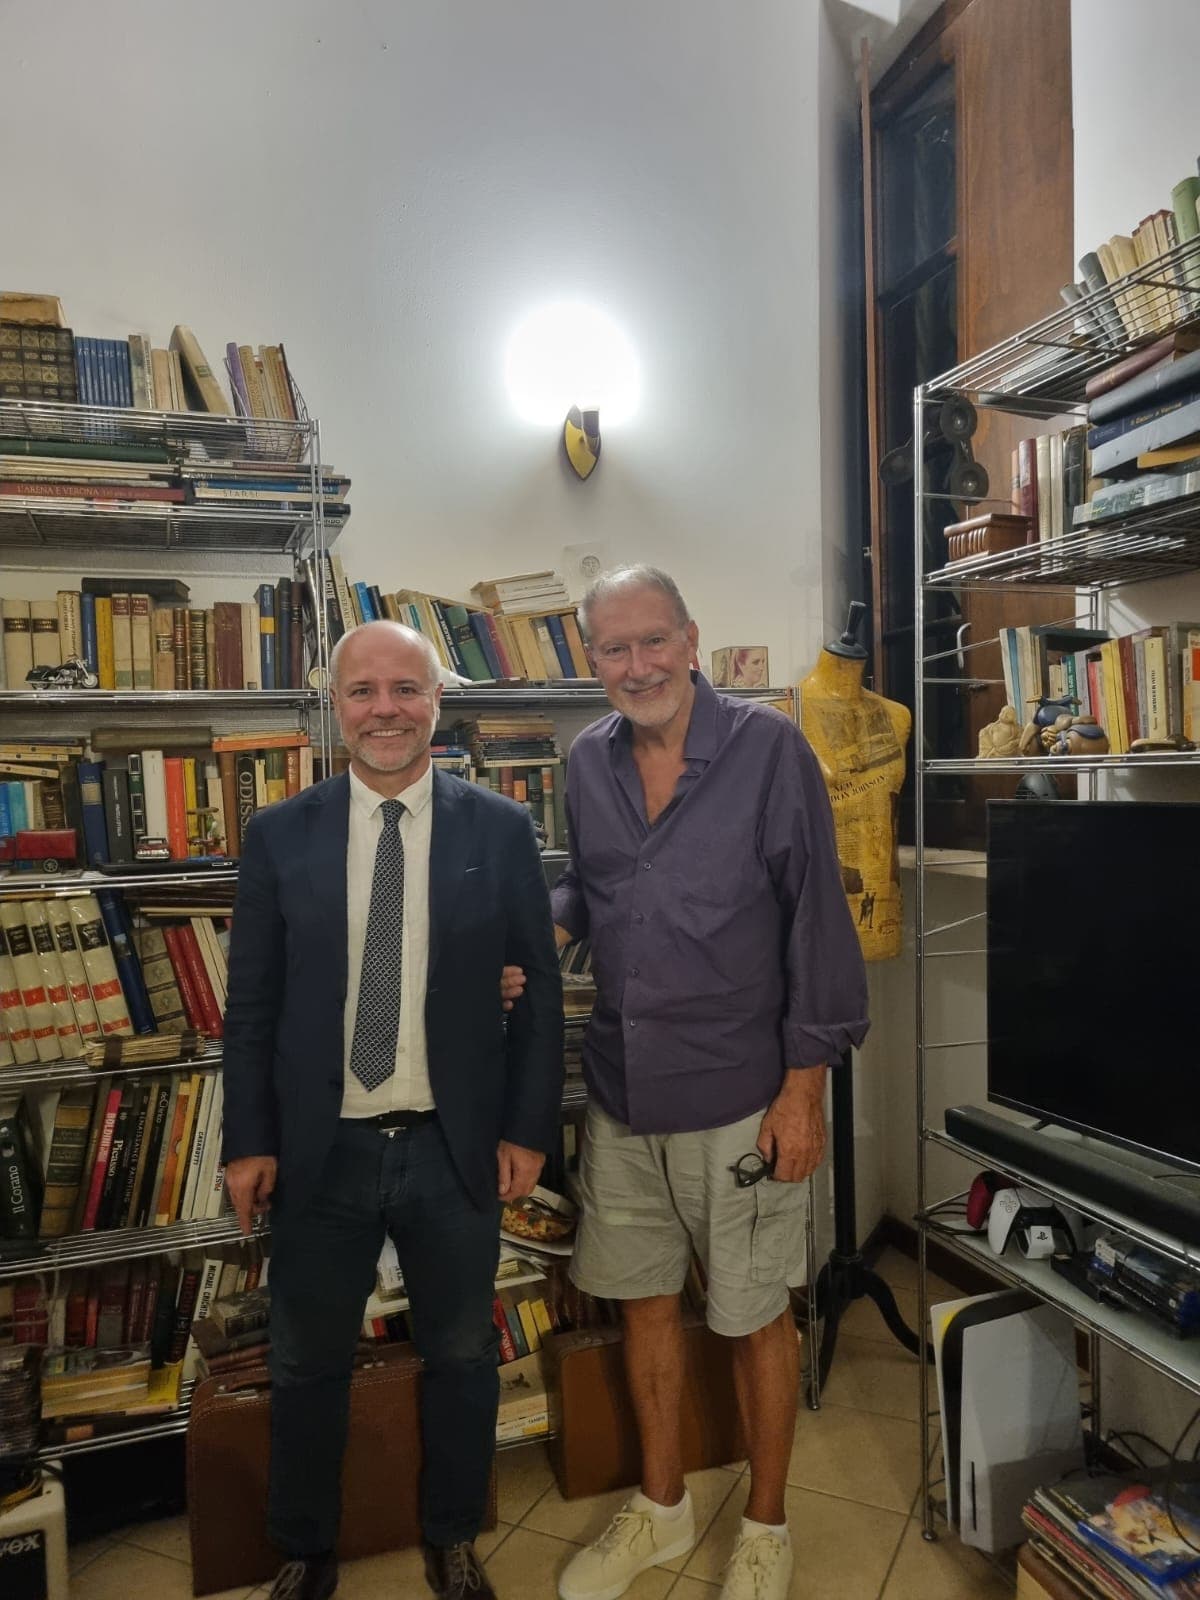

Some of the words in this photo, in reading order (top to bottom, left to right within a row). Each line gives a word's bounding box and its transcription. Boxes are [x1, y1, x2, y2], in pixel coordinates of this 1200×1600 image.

[239, 771, 254, 840] ODISS
[108, 1138, 124, 1177] Picasso
[10, 1165, 25, 1203] Corano
[205, 1264, 217, 1290] MICHAEL
